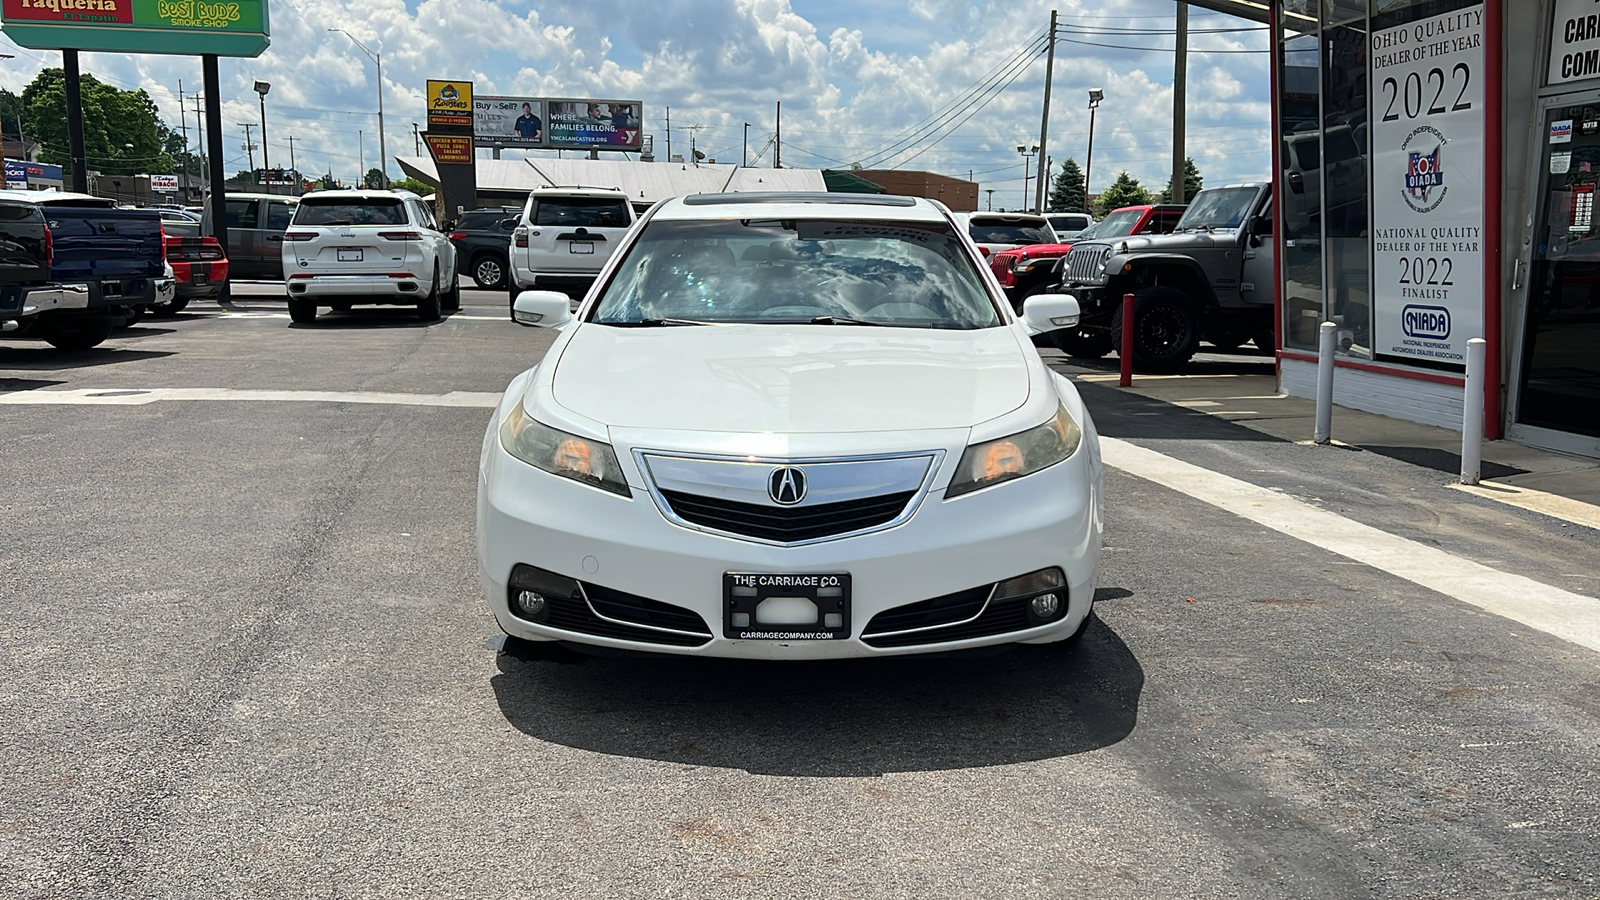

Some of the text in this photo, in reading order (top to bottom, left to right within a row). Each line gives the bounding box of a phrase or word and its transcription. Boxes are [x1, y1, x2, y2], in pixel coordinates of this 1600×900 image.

[63, 12, 118, 23] El Tapatio
[171, 18, 228, 28] SMOKE SHOP
[1373, 29, 1408, 50] OHIO
[1415, 9, 1483, 42] QUALITY
[1564, 14, 1600, 44] CAR
[1374, 33, 1481, 69] DEALER OF THE YEAR
[1562, 49, 1600, 78] COM
[1382, 62, 1472, 122] 2022
[432, 97, 468, 109] Roosters
[476, 102, 491, 110] Buy
[499, 102, 517, 110] Sell?
[551, 123, 584, 131] FAMILIES
[550, 135, 608, 143] YMCALANCASTER.ORG
[1401, 125, 1448, 151] OHIO INDEPENDENT
[1409, 174, 1437, 187] OIADA
[1375, 227, 1480, 239] NATIONAL QUALITY
[1376, 242, 1479, 252] DEALER OF THE YEAR
[1399, 257, 1453, 286] 2022
[1402, 287, 1448, 299] FINALIST
[1405, 311, 1446, 333] NIADA
[1403, 339, 1451, 350] NATIONAL INDEPENDENT
[1392, 346, 1463, 360] AUTOMOBILE DEALERS ASSOCIATION
[733, 575, 840, 586] THE CARRIAGE CO.
